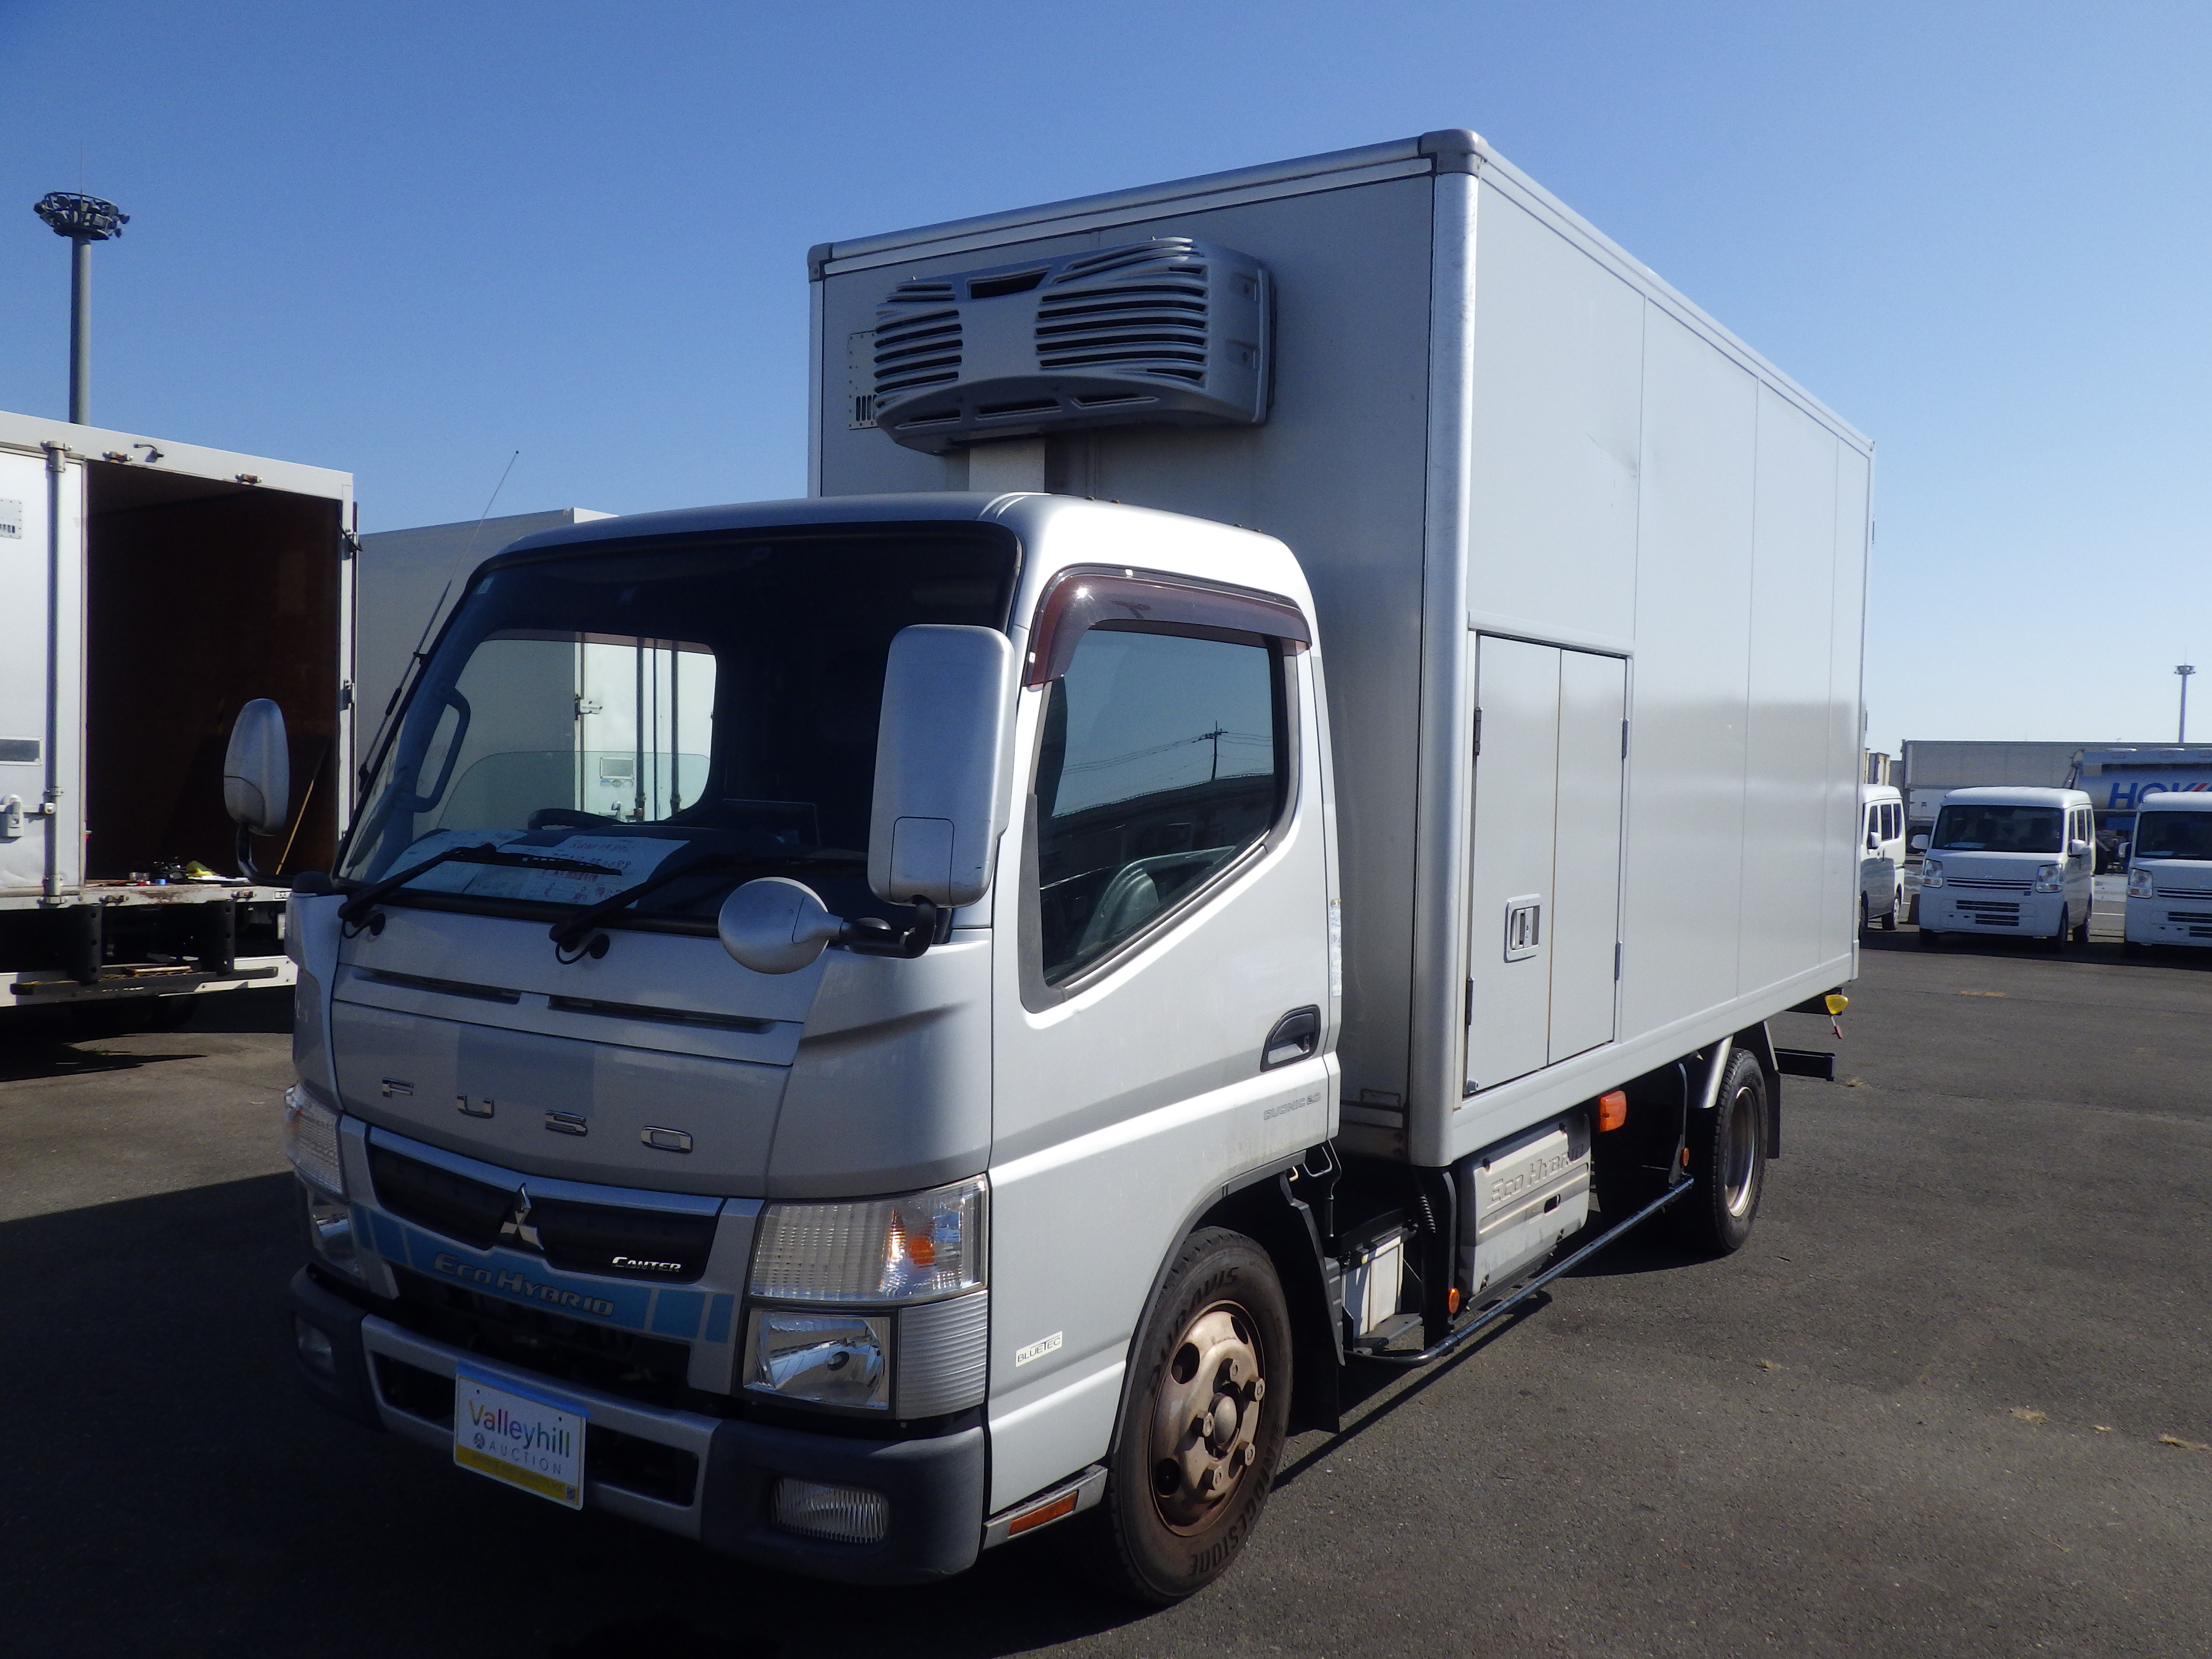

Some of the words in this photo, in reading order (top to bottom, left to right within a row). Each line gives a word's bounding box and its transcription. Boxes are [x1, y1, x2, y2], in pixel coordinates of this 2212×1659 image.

[382, 1077, 693, 1154] FUSO
[1264, 1097, 1305, 1120] DUONIC
[469, 1400, 570, 1457] Valleyhill
[489, 1441, 562, 1475] AUCTION
